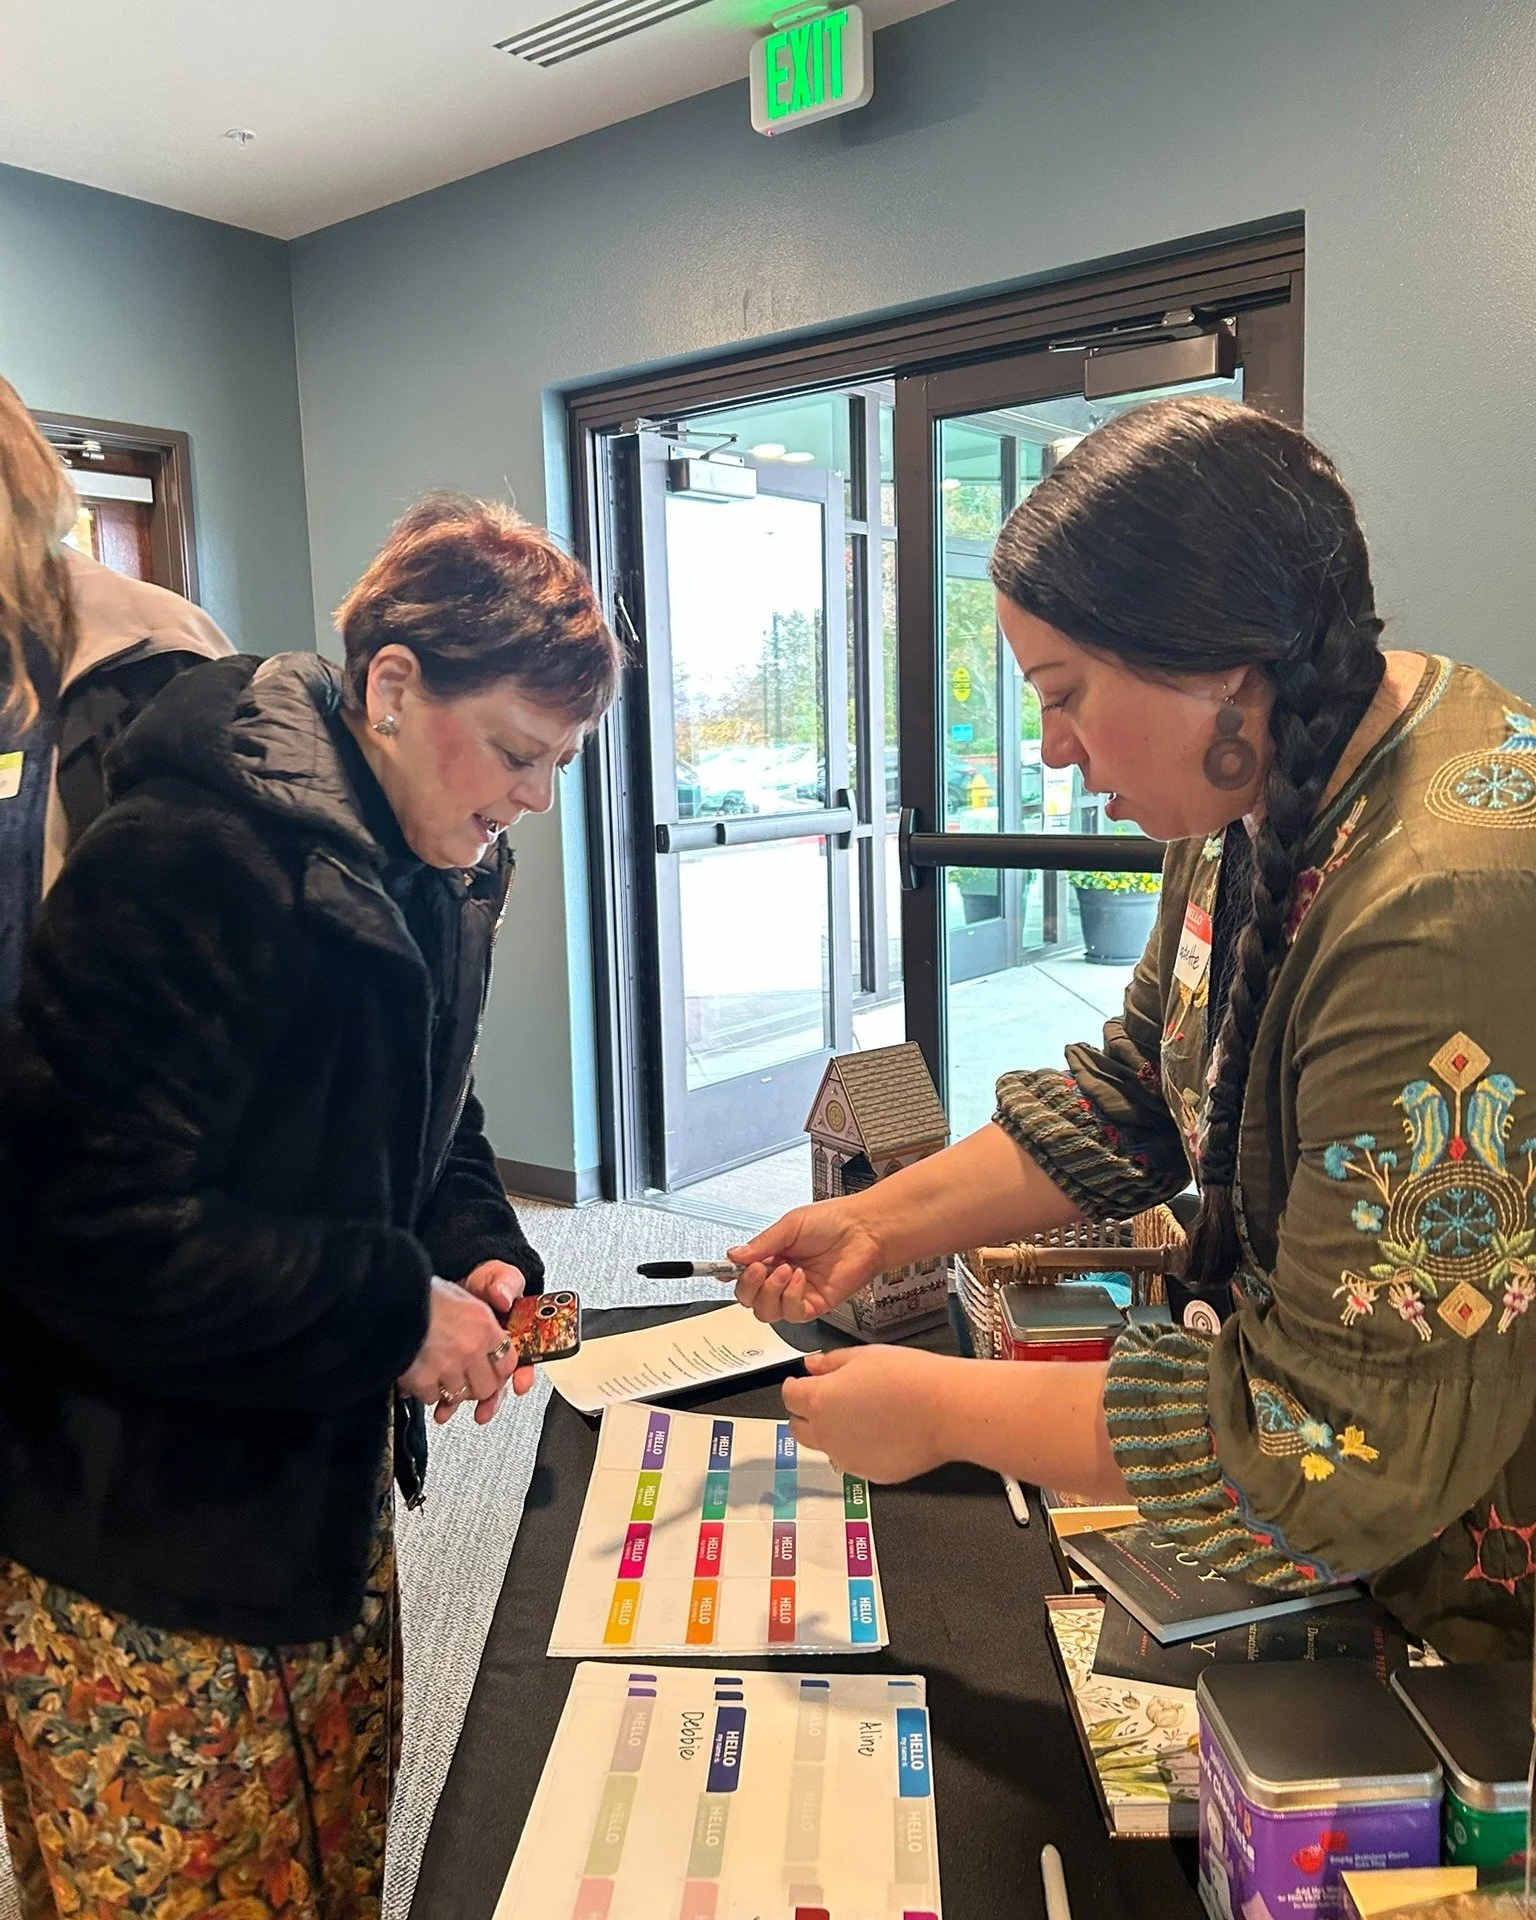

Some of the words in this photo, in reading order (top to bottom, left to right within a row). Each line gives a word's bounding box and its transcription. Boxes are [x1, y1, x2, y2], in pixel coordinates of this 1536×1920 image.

[765, 10, 848, 120] EXIT
[652, 1430, 666, 1455] HELLO
[718, 1436, 730, 1457] HELLO
[784, 1437, 795, 1456] HELLO
[642, 1486, 656, 1506] HELLO
[852, 1484, 864, 1505] HELLO
[631, 1538, 646, 1562] HELLO
[706, 1537, 719, 1560] HELLO
[781, 1536, 793, 1560] HELLO
[855, 1537, 868, 1560] HELLO
[618, 1599, 634, 1625] HELLO
[699, 1597, 712, 1624] HELLO
[780, 1597, 791, 1624] HELLO
[859, 1597, 872, 1624] HELLO
[1247, 1622, 1260, 1661] structible
[628, 1711, 648, 1747] HELLO
[679, 1711, 704, 1760] Debbie
[858, 1721, 882, 1757] Aline
[722, 1730, 740, 1767] HELLO
[909, 1733, 925, 1771] HELLO
[606, 1802, 624, 1843] HELLO
[705, 1806, 723, 1846] HELLO
[907, 1811, 922, 1852] HELLO
